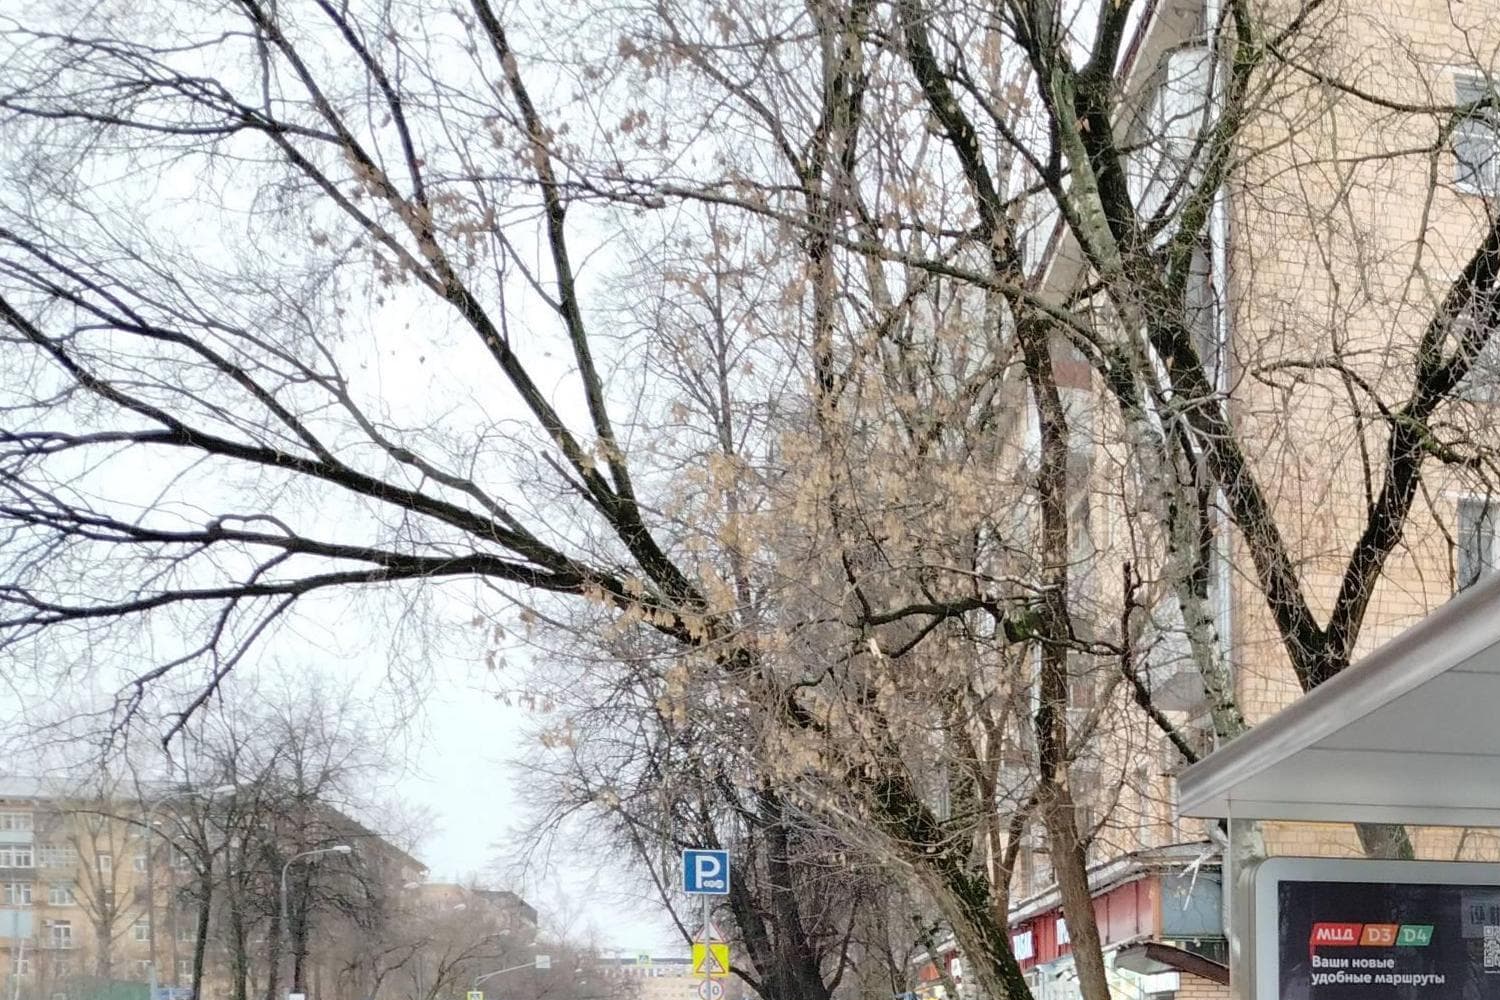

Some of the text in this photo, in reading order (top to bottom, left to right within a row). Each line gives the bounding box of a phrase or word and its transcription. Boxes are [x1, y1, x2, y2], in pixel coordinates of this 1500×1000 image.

[1316, 928, 1427, 943] МЦД D3 D4
[1312, 955, 1395, 969] Ваши новые
[1311, 971, 1446, 987] удобные маршруты
